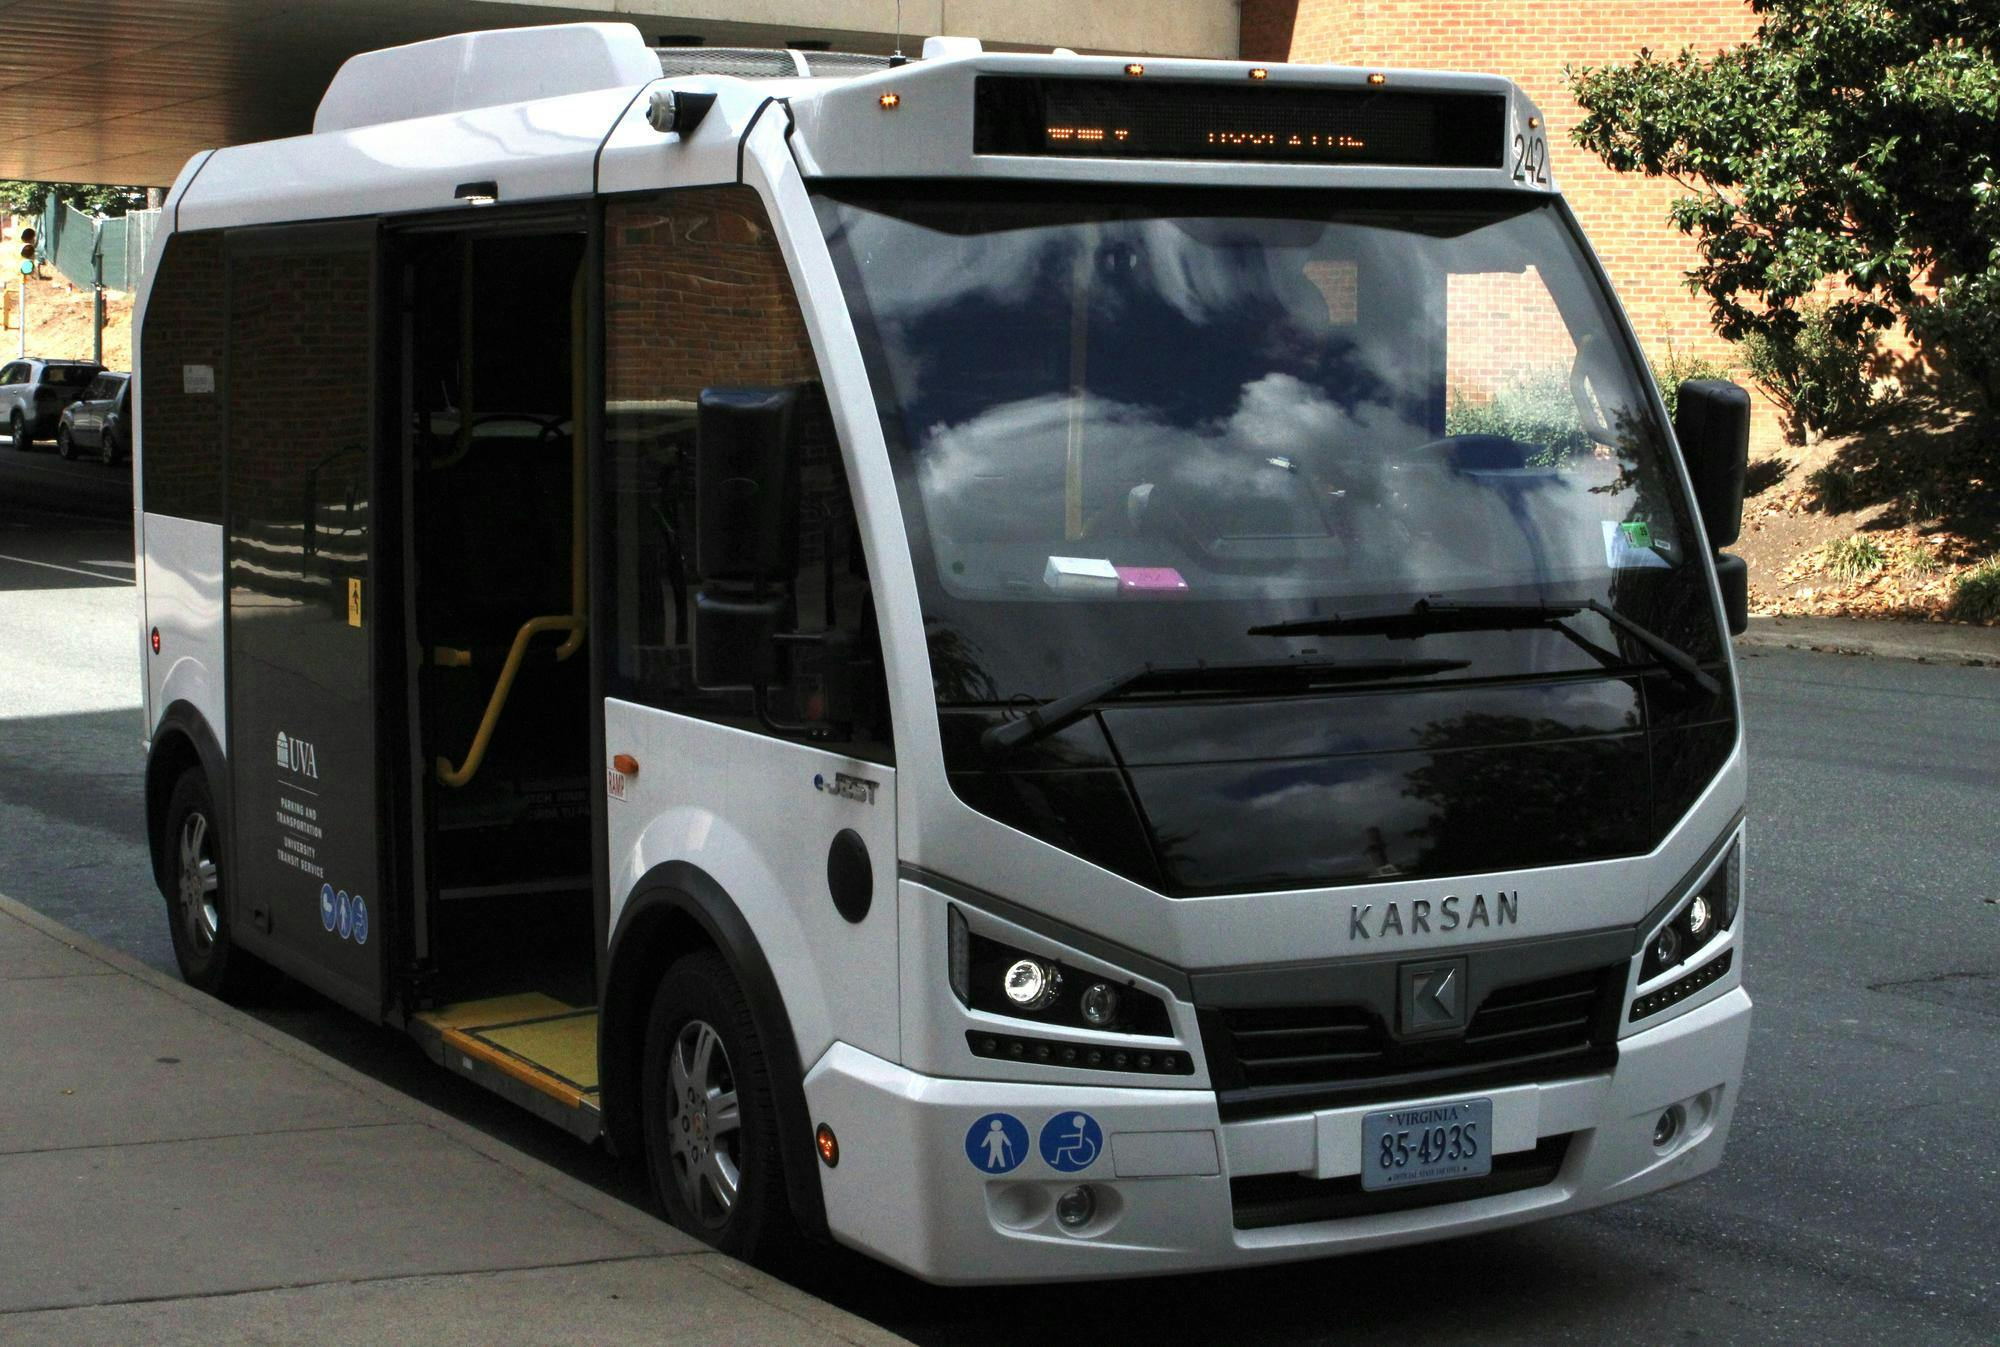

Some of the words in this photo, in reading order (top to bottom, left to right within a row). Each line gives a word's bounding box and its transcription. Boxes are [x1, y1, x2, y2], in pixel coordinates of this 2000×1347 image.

[1512, 133, 1547, 184] 242
[289, 737, 318, 778] UVA
[608, 769, 624, 797] RAMP
[281, 797, 304, 816] PARKING
[305, 807, 317, 821] AND
[276, 811, 322, 839] TRANSPORTATION
[283, 835, 316, 860] UNIVERSITY
[277, 848, 299, 867] TRANSIT
[300, 859, 324, 879] SERVICE
[1349, 889, 1519, 941] KARSAN
[1396, 1106, 1459, 1127] VIRGINIA
[1380, 1121, 1478, 1170] 85-493S
